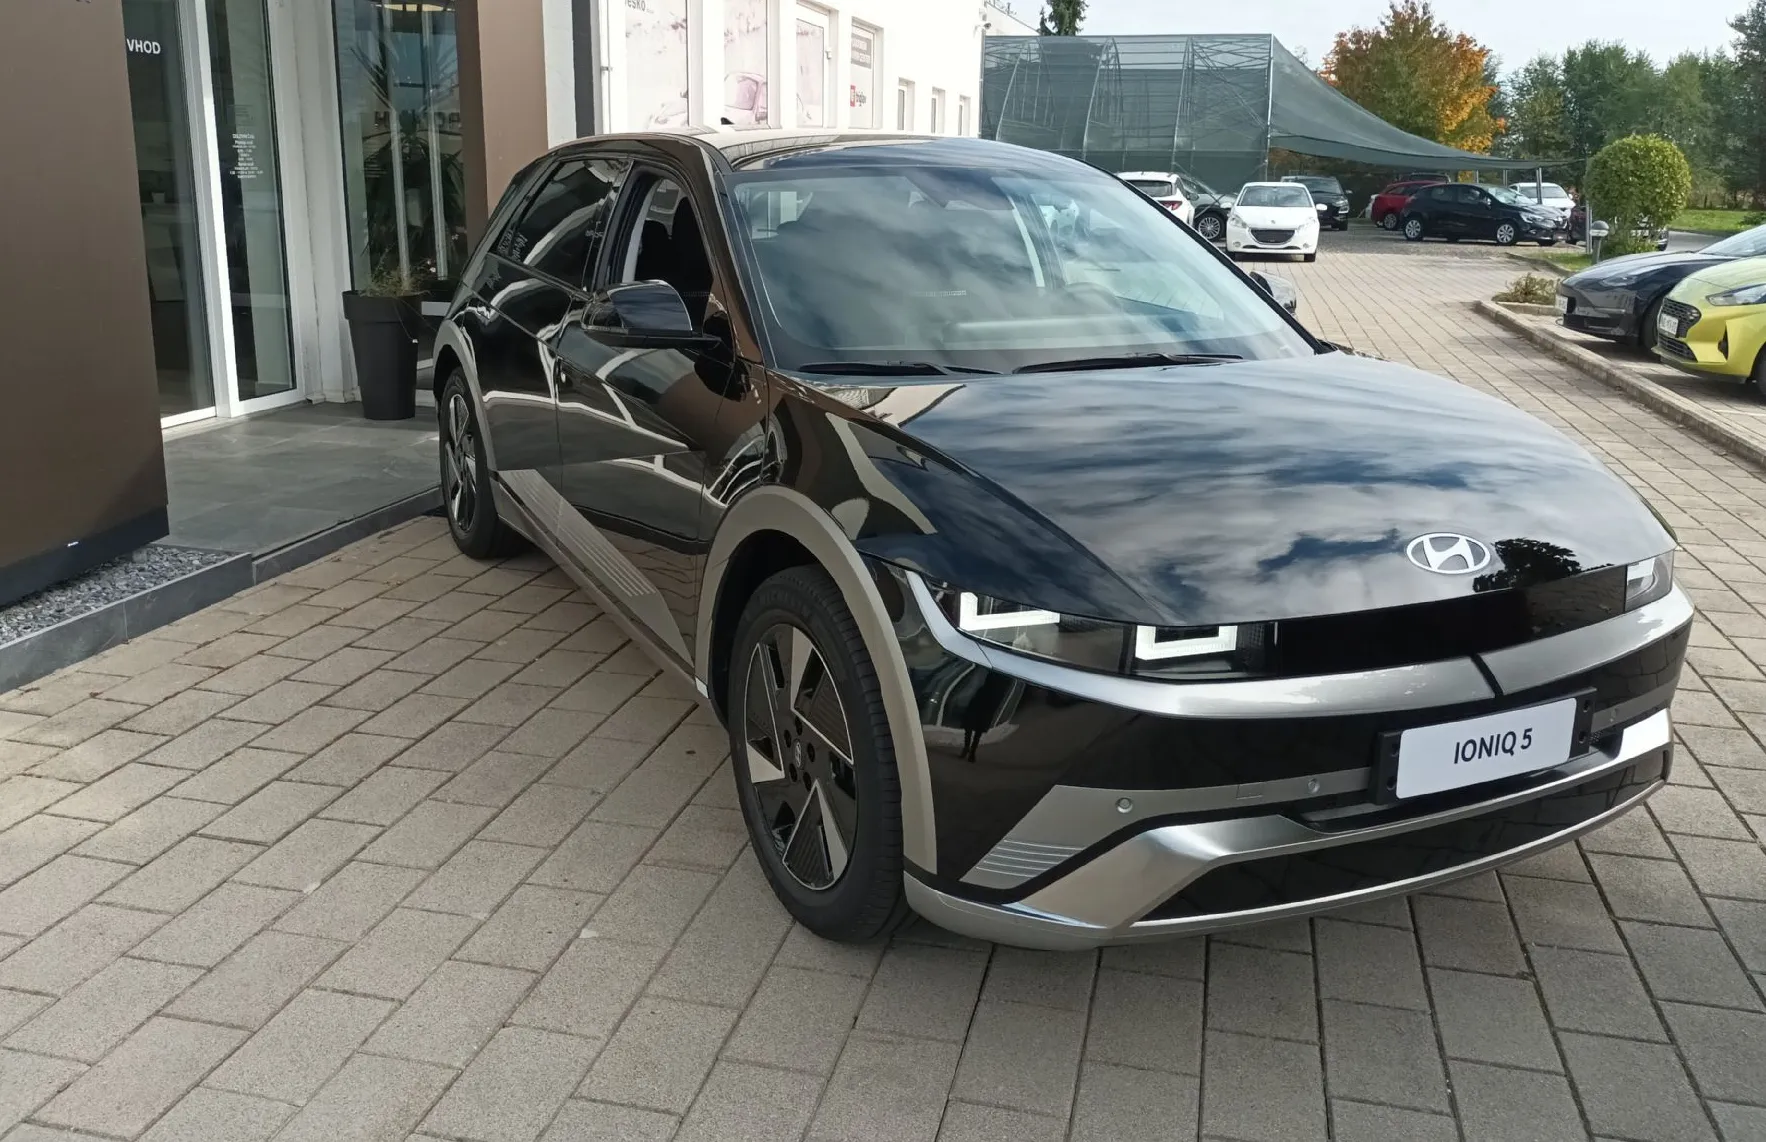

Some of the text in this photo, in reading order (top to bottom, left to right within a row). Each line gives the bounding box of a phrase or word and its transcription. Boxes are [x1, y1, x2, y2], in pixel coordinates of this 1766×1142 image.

[126, 38, 161, 54] VHOD
[1453, 727, 1533, 765] IONIQ 5
